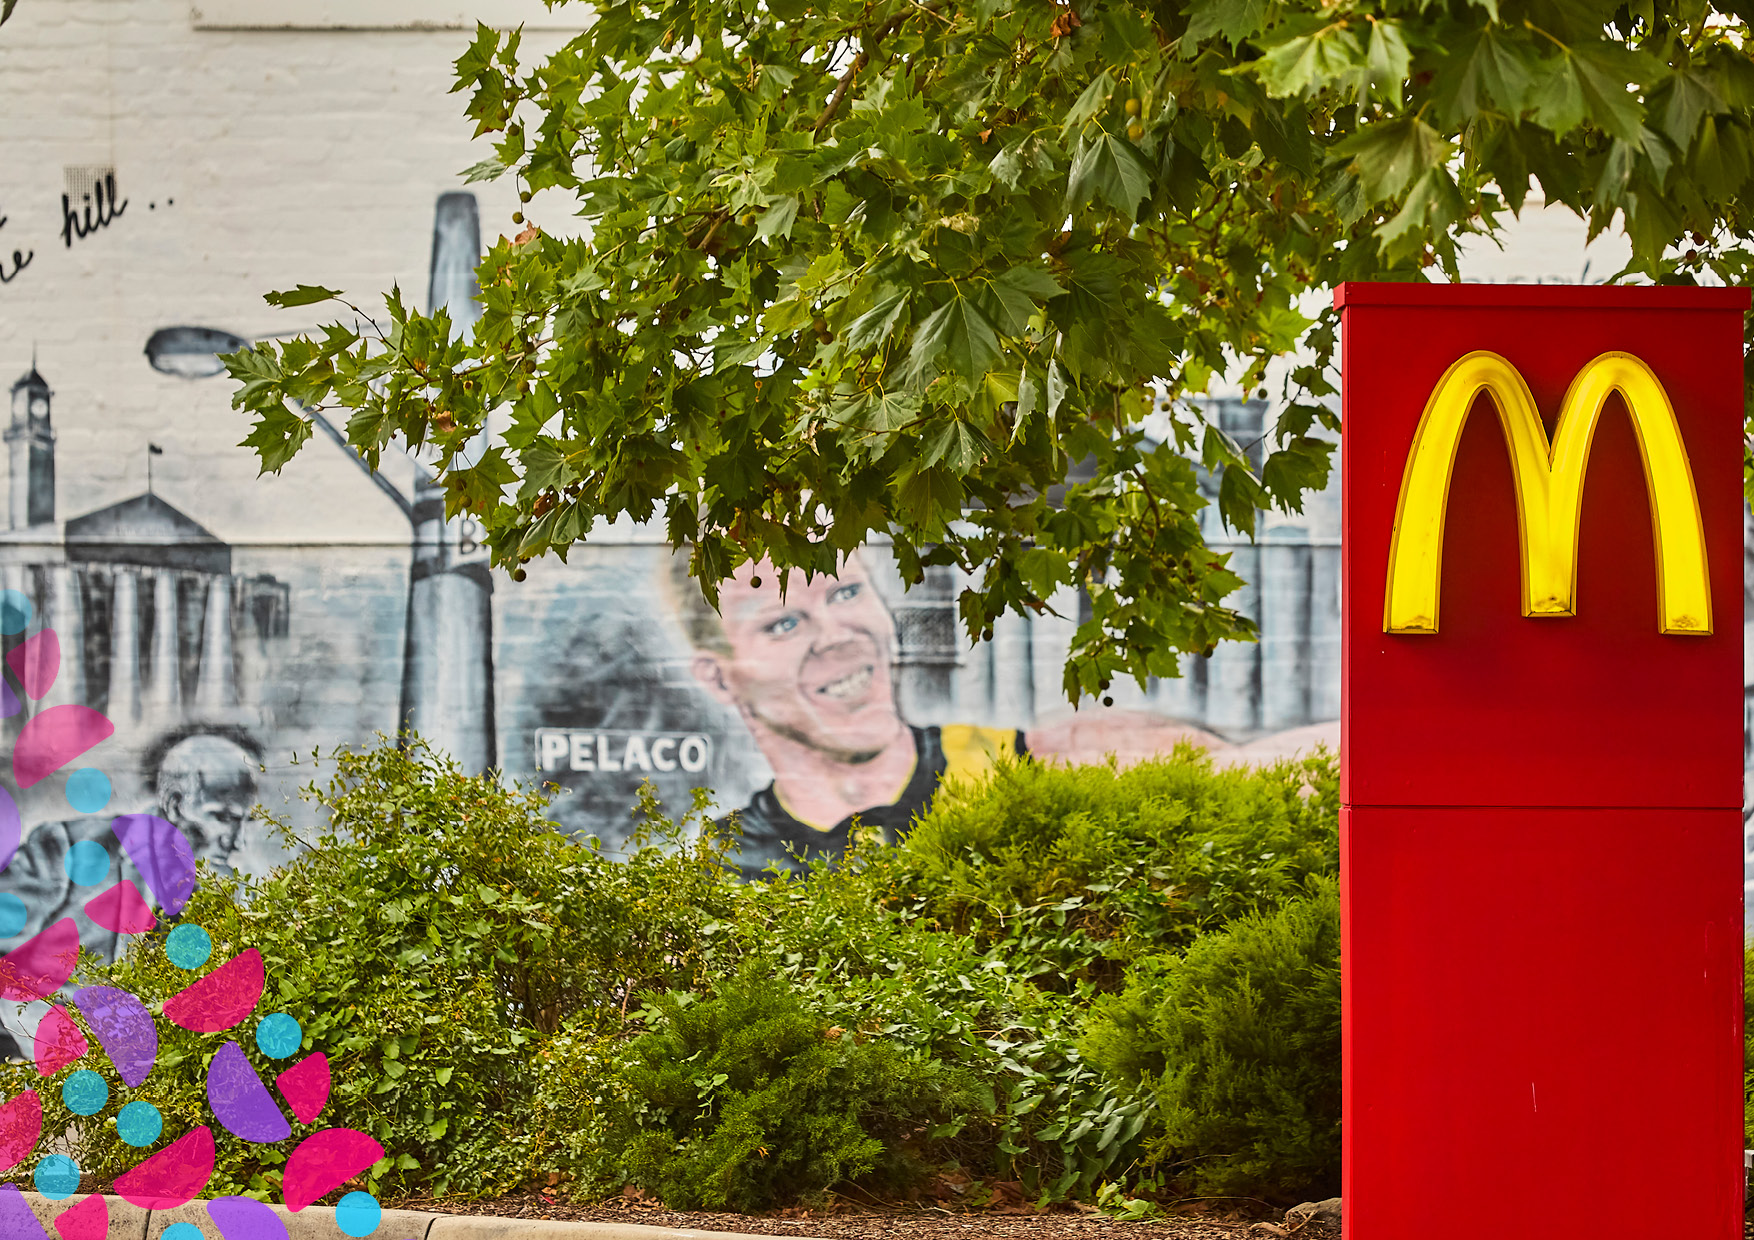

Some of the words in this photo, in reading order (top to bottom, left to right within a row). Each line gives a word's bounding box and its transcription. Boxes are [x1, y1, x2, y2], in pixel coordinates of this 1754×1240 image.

[60, 173, 128, 248] hill
[1383, 350, 1714, 635] M
[541, 734, 708, 773] PELACO
